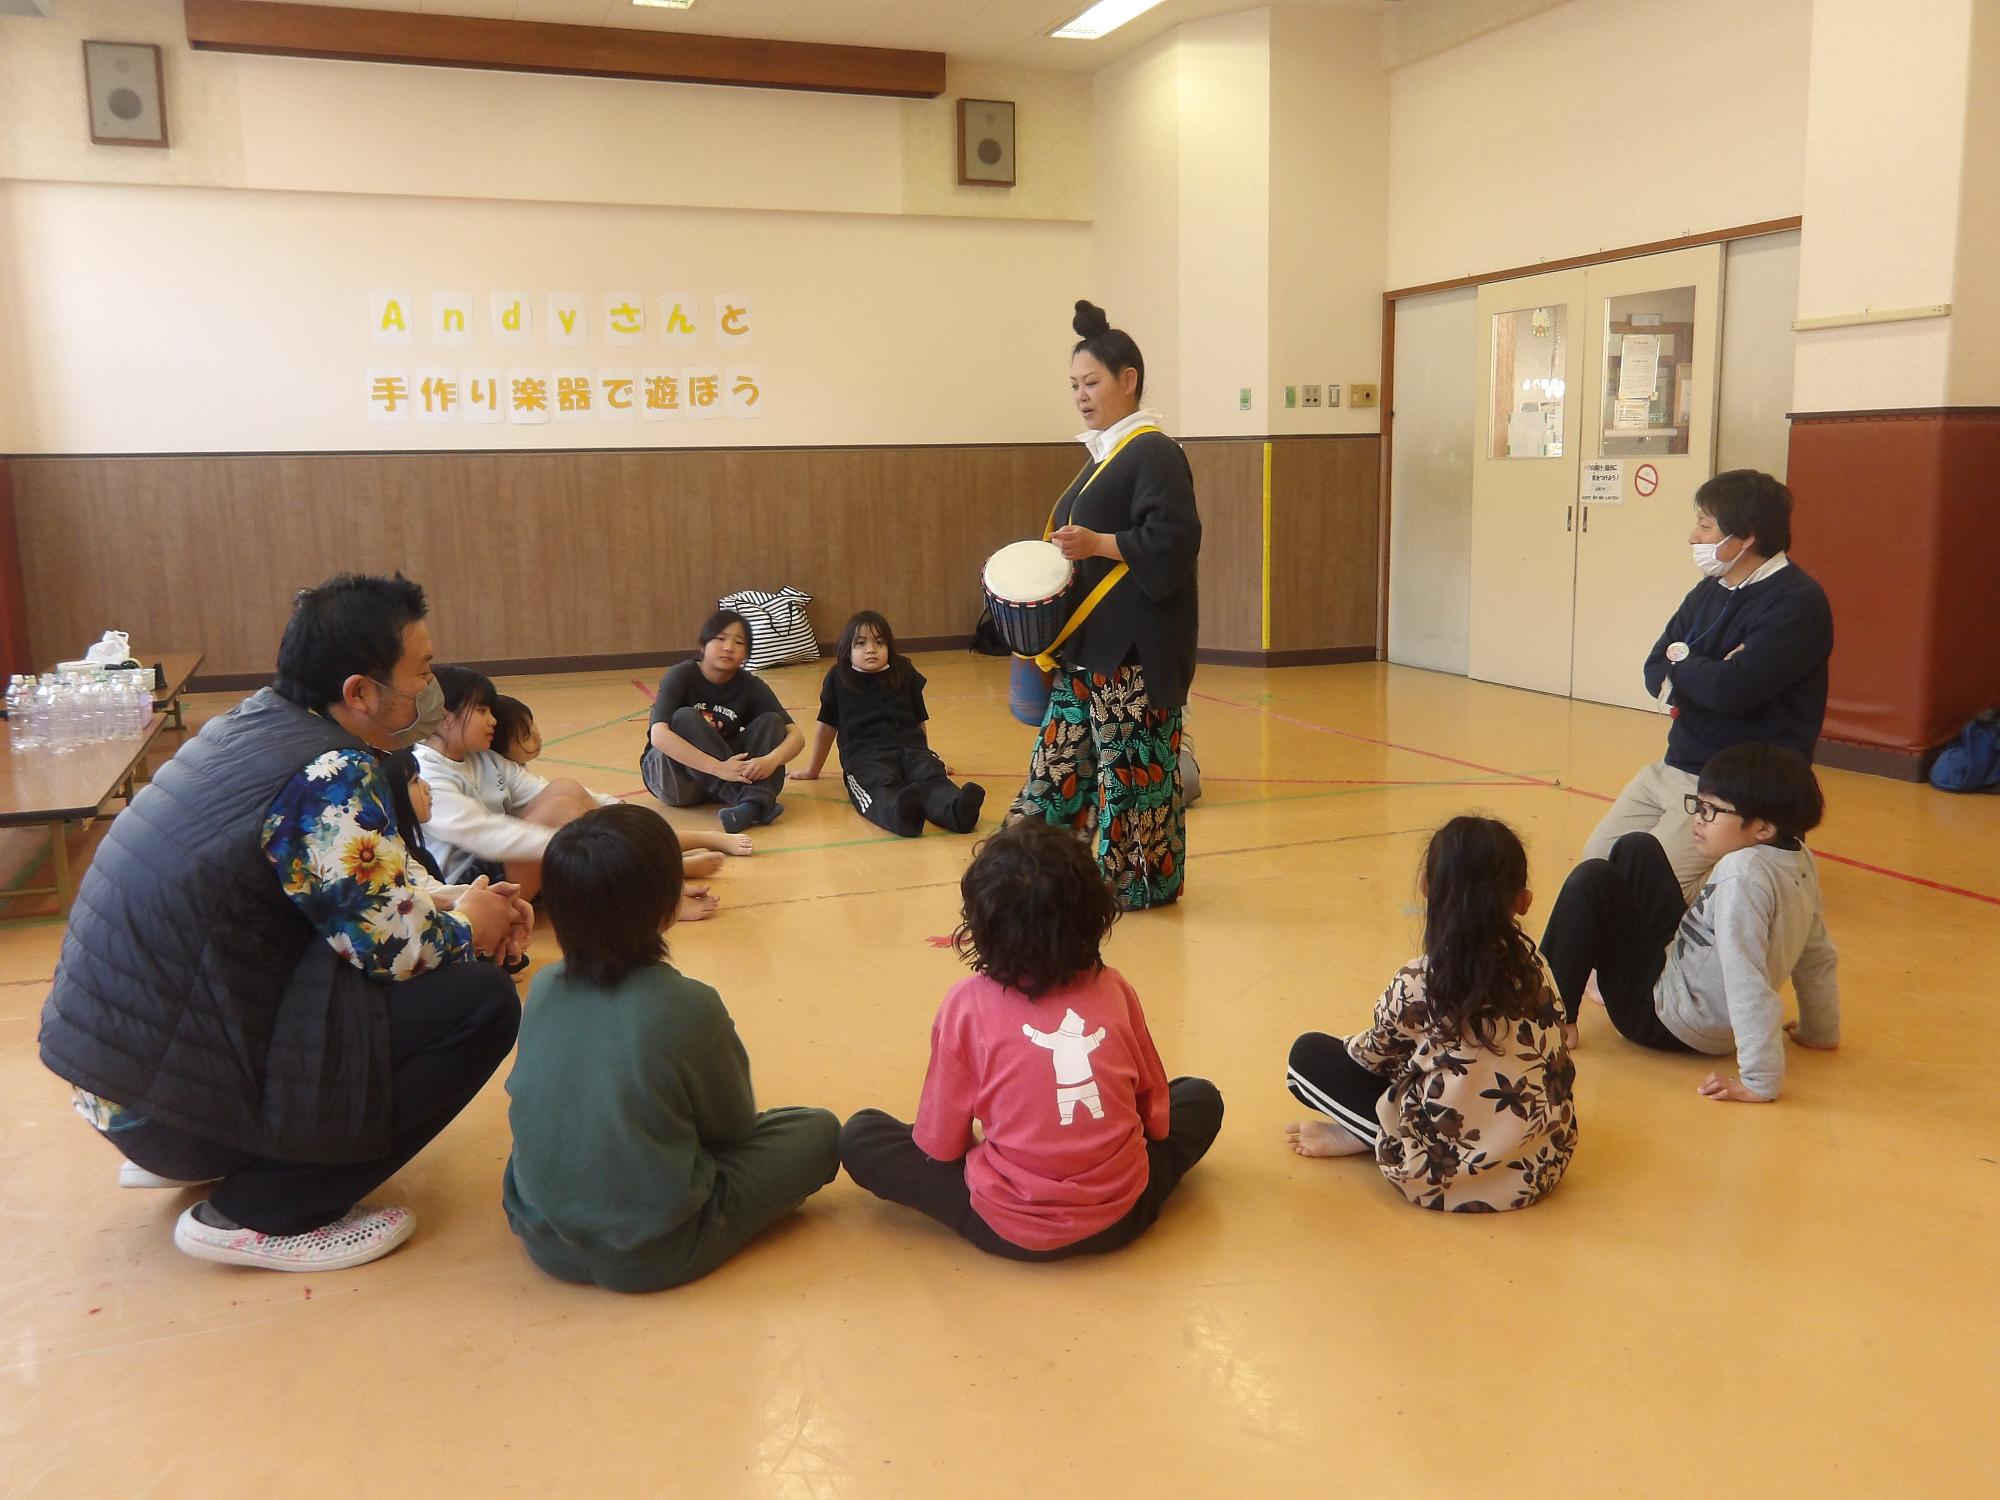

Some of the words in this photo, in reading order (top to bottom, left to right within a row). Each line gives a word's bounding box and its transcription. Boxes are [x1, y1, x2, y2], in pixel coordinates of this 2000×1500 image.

[372, 375, 760, 411] 手作り楽器で遊ぼう
